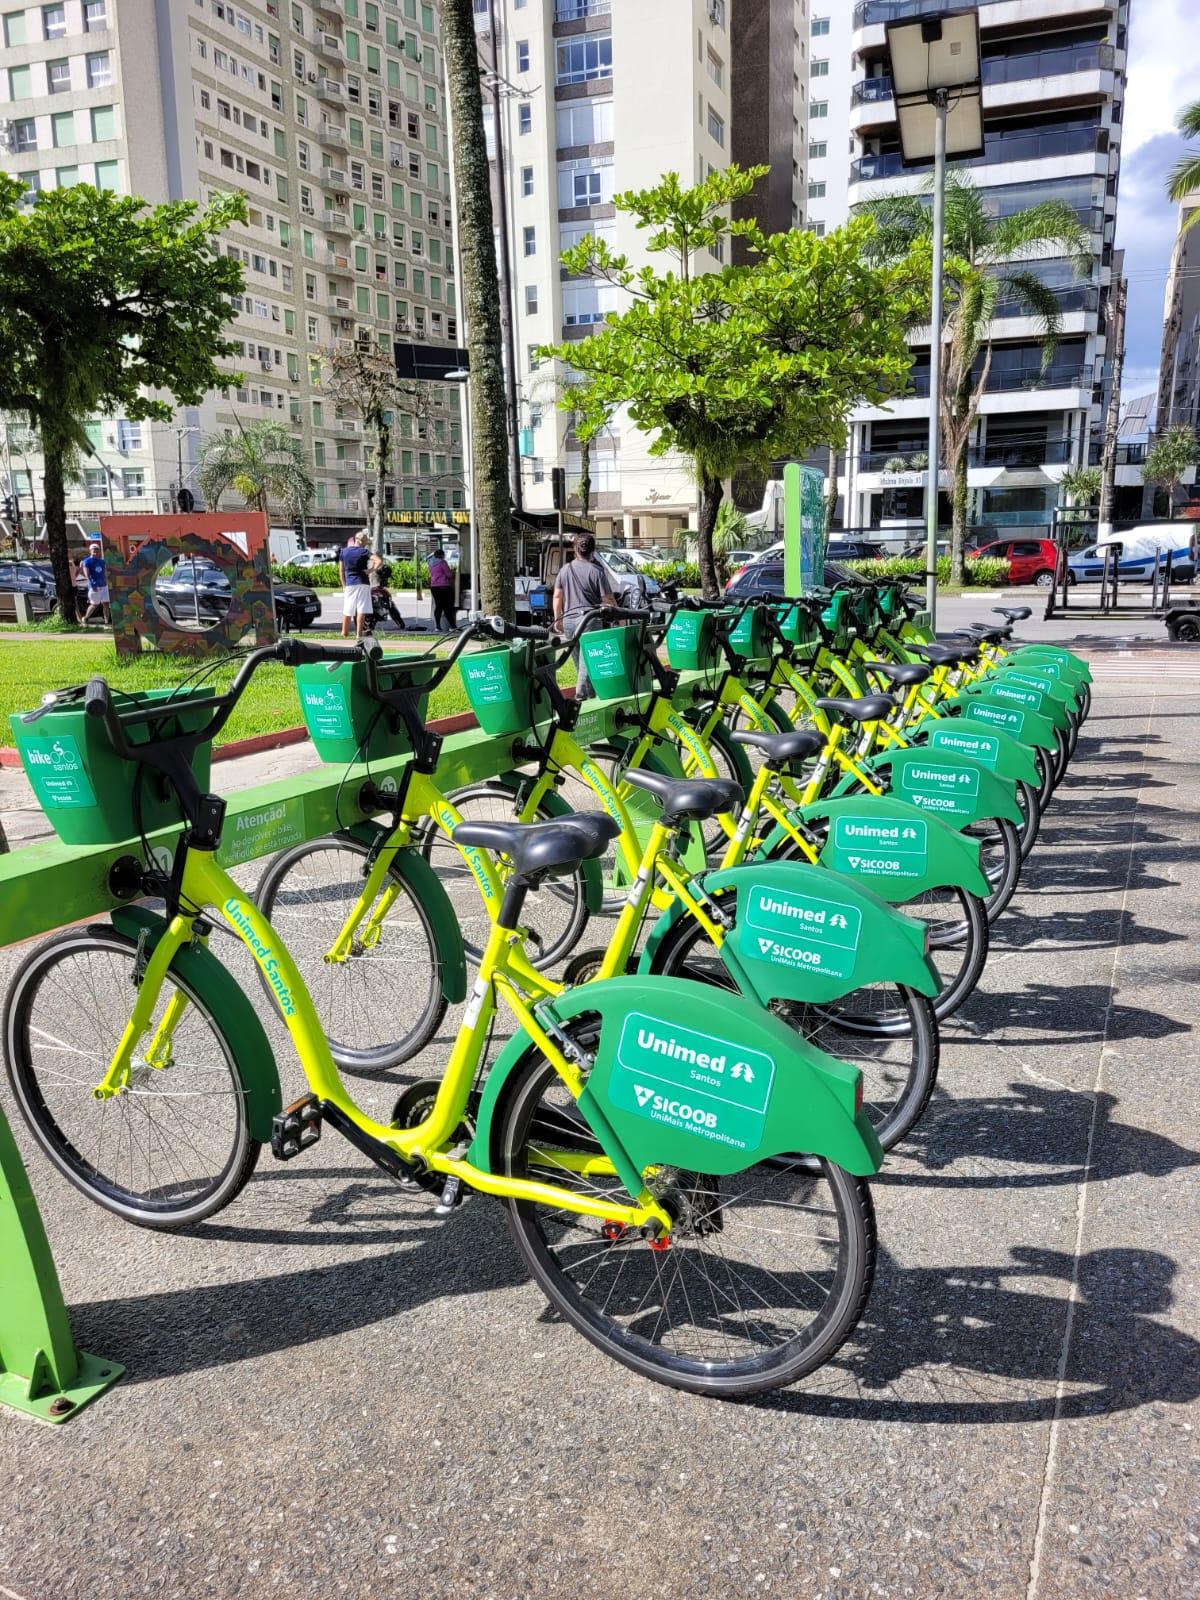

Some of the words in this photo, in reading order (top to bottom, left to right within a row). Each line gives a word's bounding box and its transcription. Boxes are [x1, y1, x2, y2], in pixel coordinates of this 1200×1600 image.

[387, 511, 411, 523] CALDO
[414, 511, 424, 523] DE
[425, 511, 447, 524] CANA
[305, 693, 324, 706] bike
[996, 688, 1027, 700] Unimed
[973, 708, 1007, 721] Unimed
[940, 736, 979, 749] Unimed
[27, 749, 52, 764] bike
[53, 763, 79, 771] santos
[911, 769, 956, 782] Unimed
[922, 797, 955, 808] SICOOB
[236, 803, 286, 831] Atenção!
[845, 824, 899, 838] Unimed
[860, 859, 900, 870] SICOOB
[471, 855, 494, 899] Santos
[759, 896, 826, 924] Unimed
[799, 922, 823, 934] Santos
[224, 896, 271, 958] Unimed
[264, 958, 296, 1016] Santos
[772, 944, 821, 965] SICOOB
[770, 955, 796, 967] UniMais
[796, 961, 843, 978] Metropolitana
[637, 1029, 727, 1074] Unimed
[690, 1069, 721, 1087] Santos
[652, 1095, 718, 1129] SICOOB
[650, 1111, 683, 1129] UniMais
[684, 1121, 746, 1149] Metropolitana
